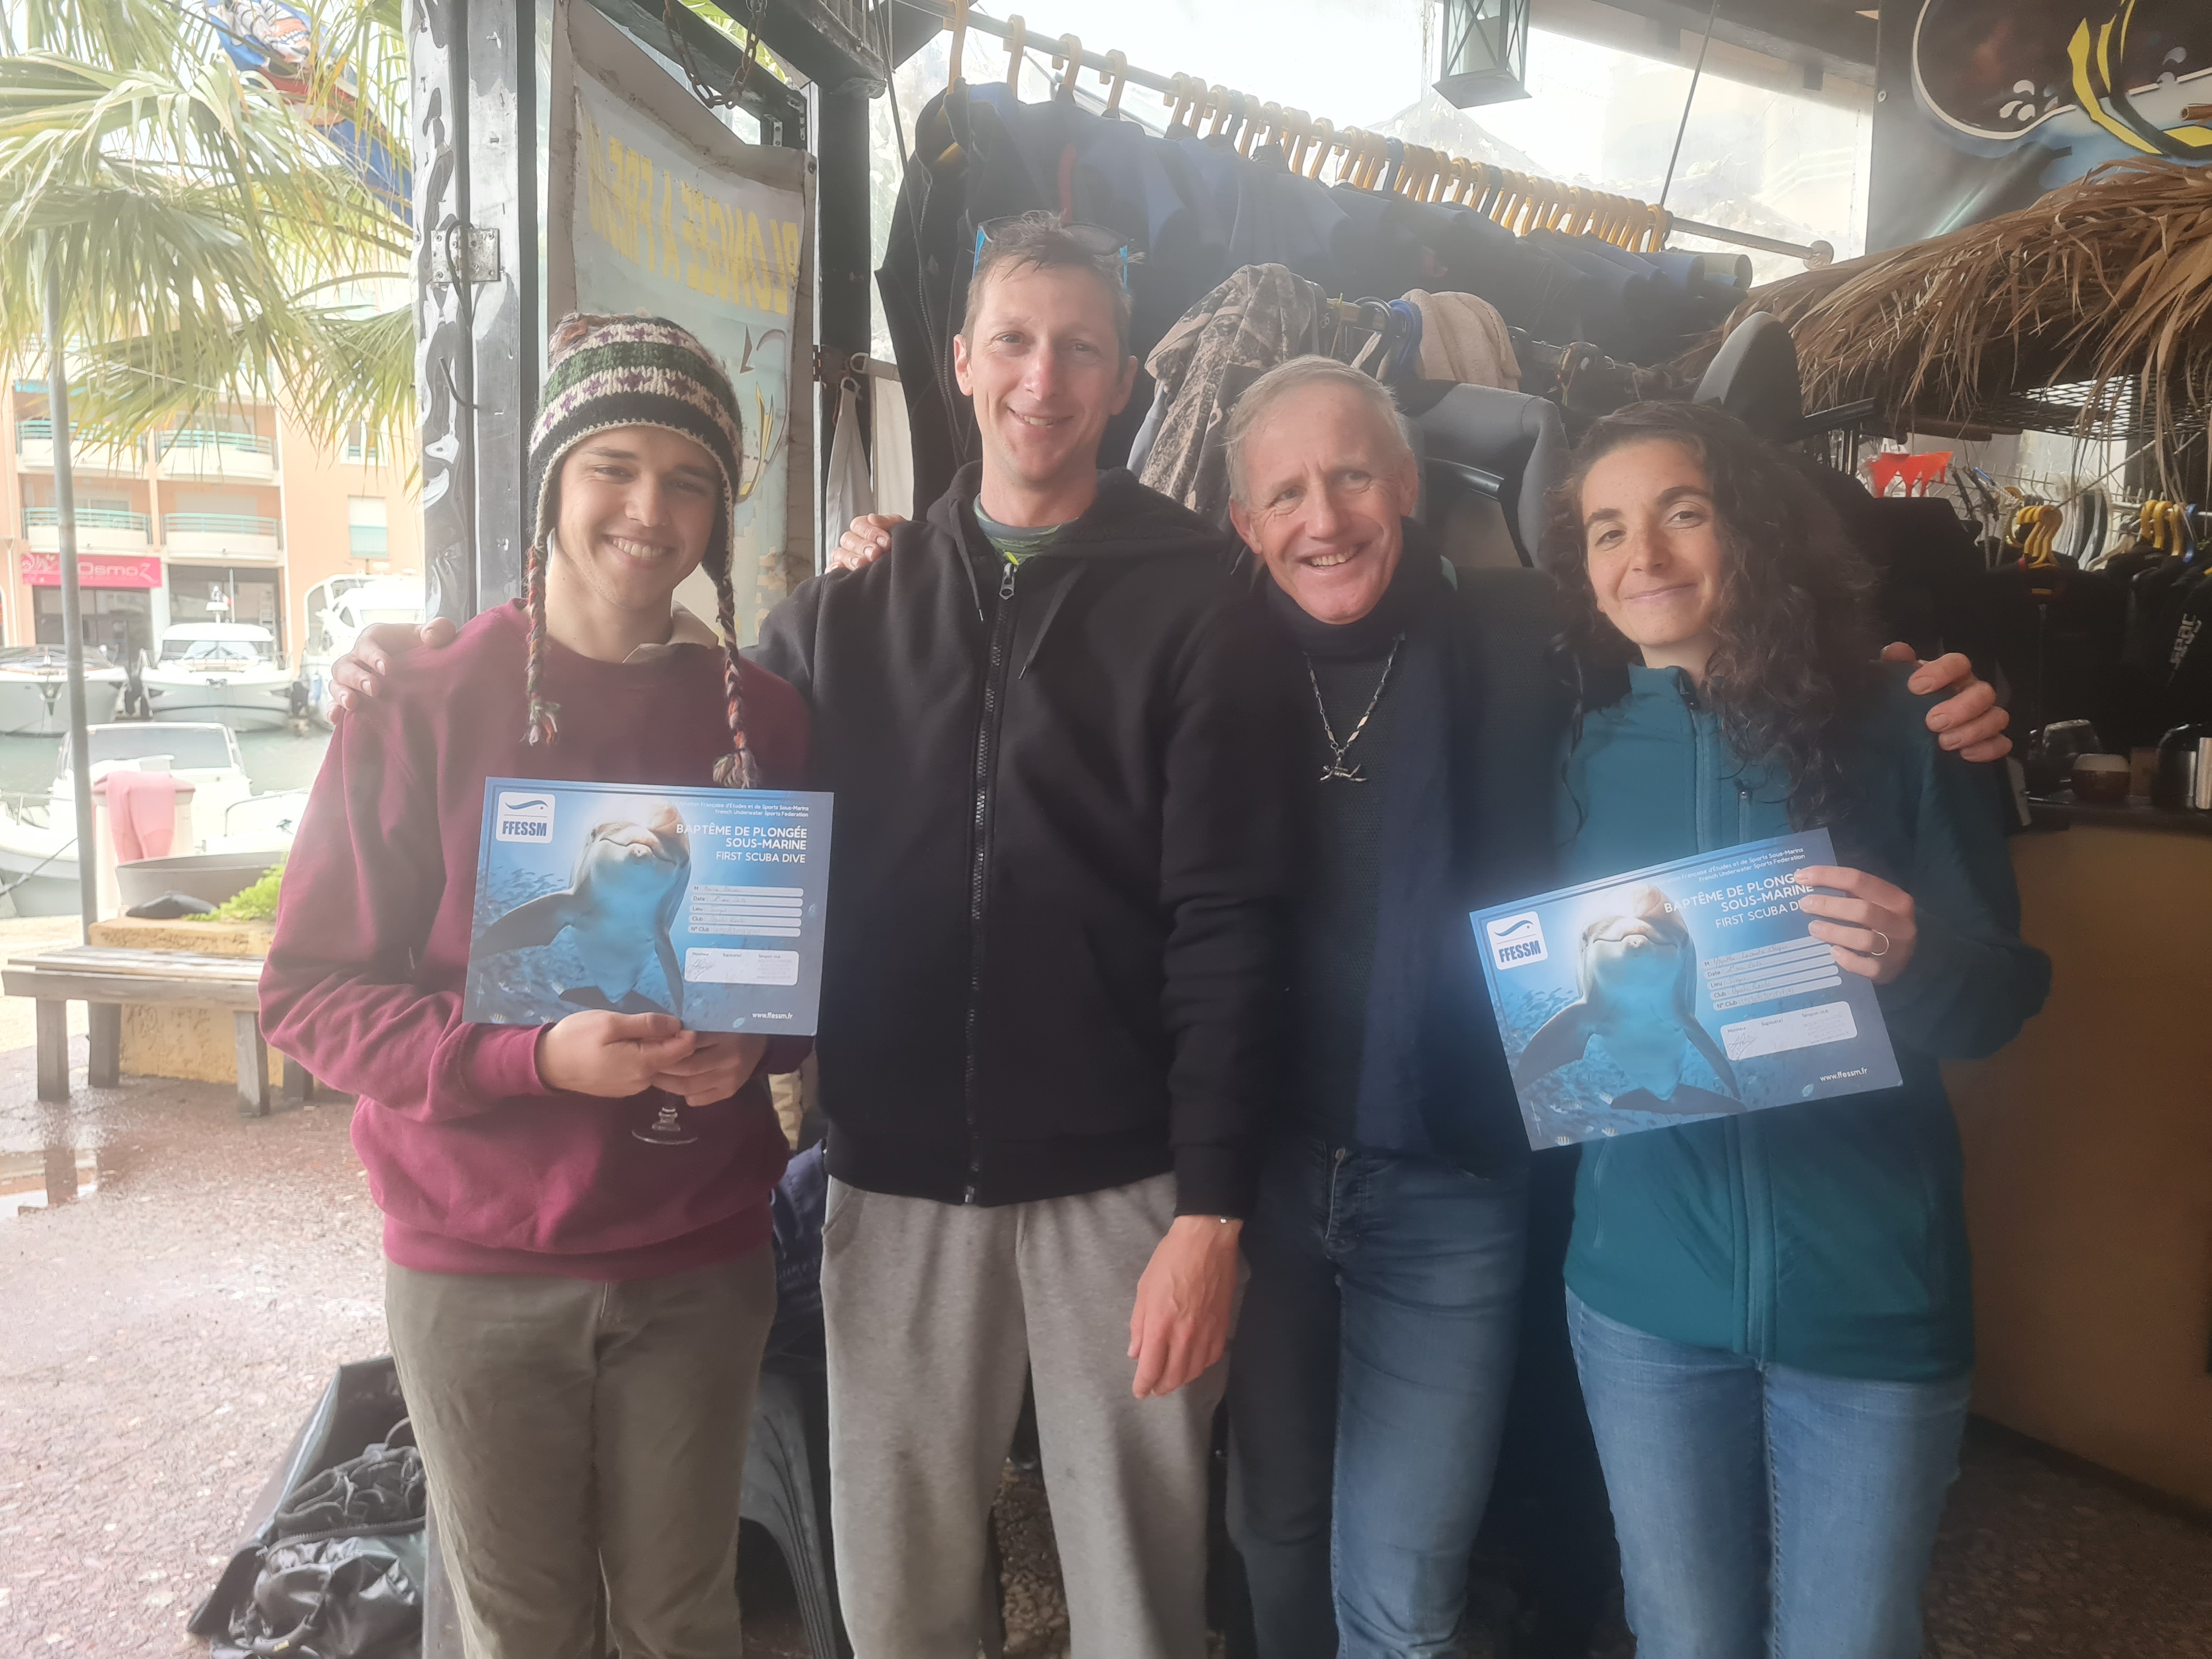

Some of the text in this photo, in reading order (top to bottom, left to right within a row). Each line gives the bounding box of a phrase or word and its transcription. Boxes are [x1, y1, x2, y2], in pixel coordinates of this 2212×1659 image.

[502, 821, 547, 837] FFESSM
[676, 822, 808, 839] BAPTÊME DE PLONGÉE
[726, 838, 807, 850] SOUS-MARINE
[716, 851, 806, 864] FIRST SCUBA DIVE
[1749, 855, 1768, 864] Sports
[1769, 847, 1803, 859] Sous-Marins
[1699, 854, 1805, 882] French Underwater Sports Federation
[1663, 872, 1800, 912] BAPTÊME DE PLONG
[1720, 885, 1814, 911] SOUS-MARINE
[1716, 913, 1745, 928] FIRST
[1747, 904, 1788, 921] SCUBA
[1498, 940, 1541, 963] FFESSM
[1819, 1067, 1867, 1082] www.ffessm.fr
